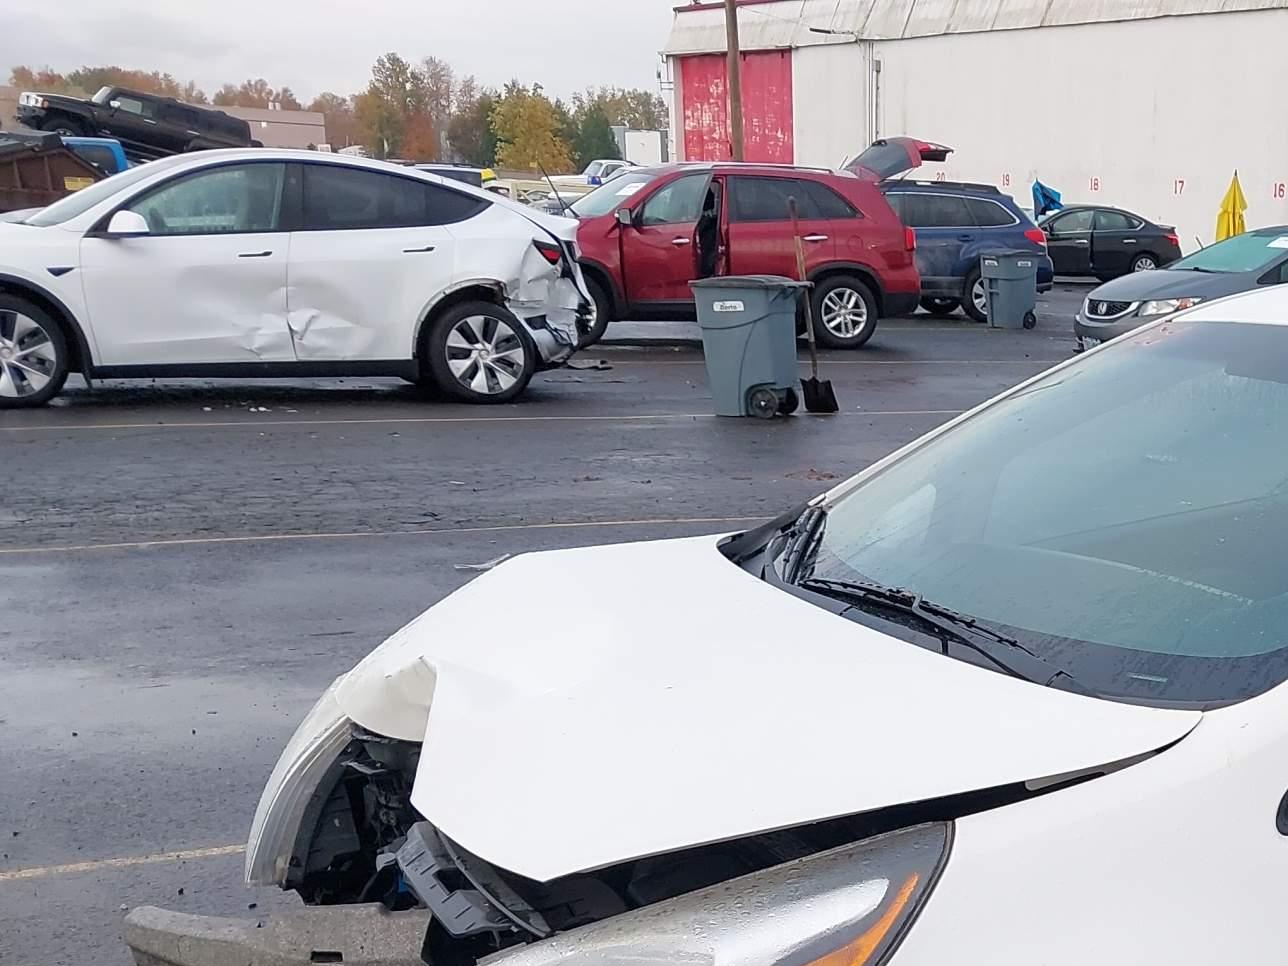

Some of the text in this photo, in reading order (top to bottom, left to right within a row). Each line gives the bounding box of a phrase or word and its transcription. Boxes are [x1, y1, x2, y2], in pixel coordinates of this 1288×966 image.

[1002, 174, 1010, 186] 19
[1090, 177, 1099, 191] 18
[1174, 180, 1185, 195] 17
[1273, 183, 1285, 198] 16
